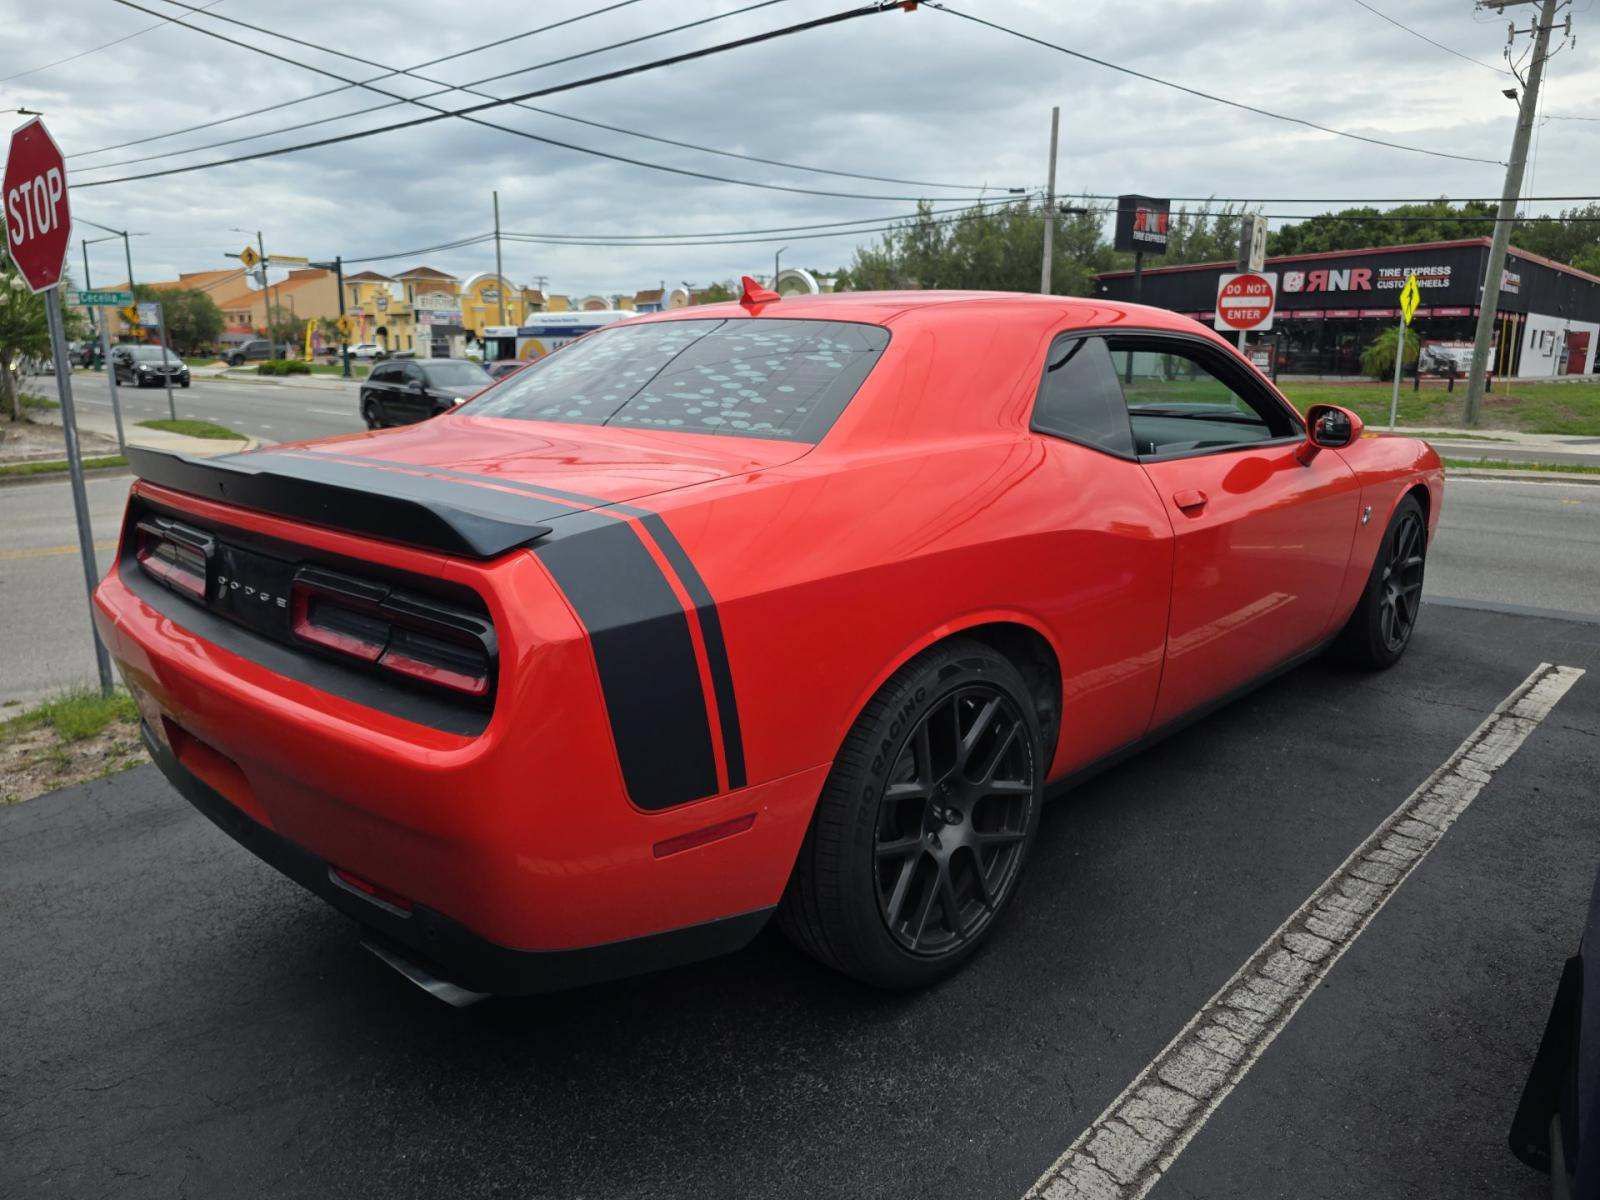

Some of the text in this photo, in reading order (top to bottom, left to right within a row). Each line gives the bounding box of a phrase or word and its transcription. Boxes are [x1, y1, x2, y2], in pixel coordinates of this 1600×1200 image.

[8, 167, 63, 246] STOP
[1307, 268, 1372, 291] RNR
[1379, 266, 1452, 277] TIRE EXPRESS
[1226, 284, 1267, 295] DO NOT
[1376, 280, 1405, 289] CUSTO
[1227, 310, 1261, 319] ENTER
[217, 575, 287, 608] DODGE
[871, 686, 927, 777] RACING
